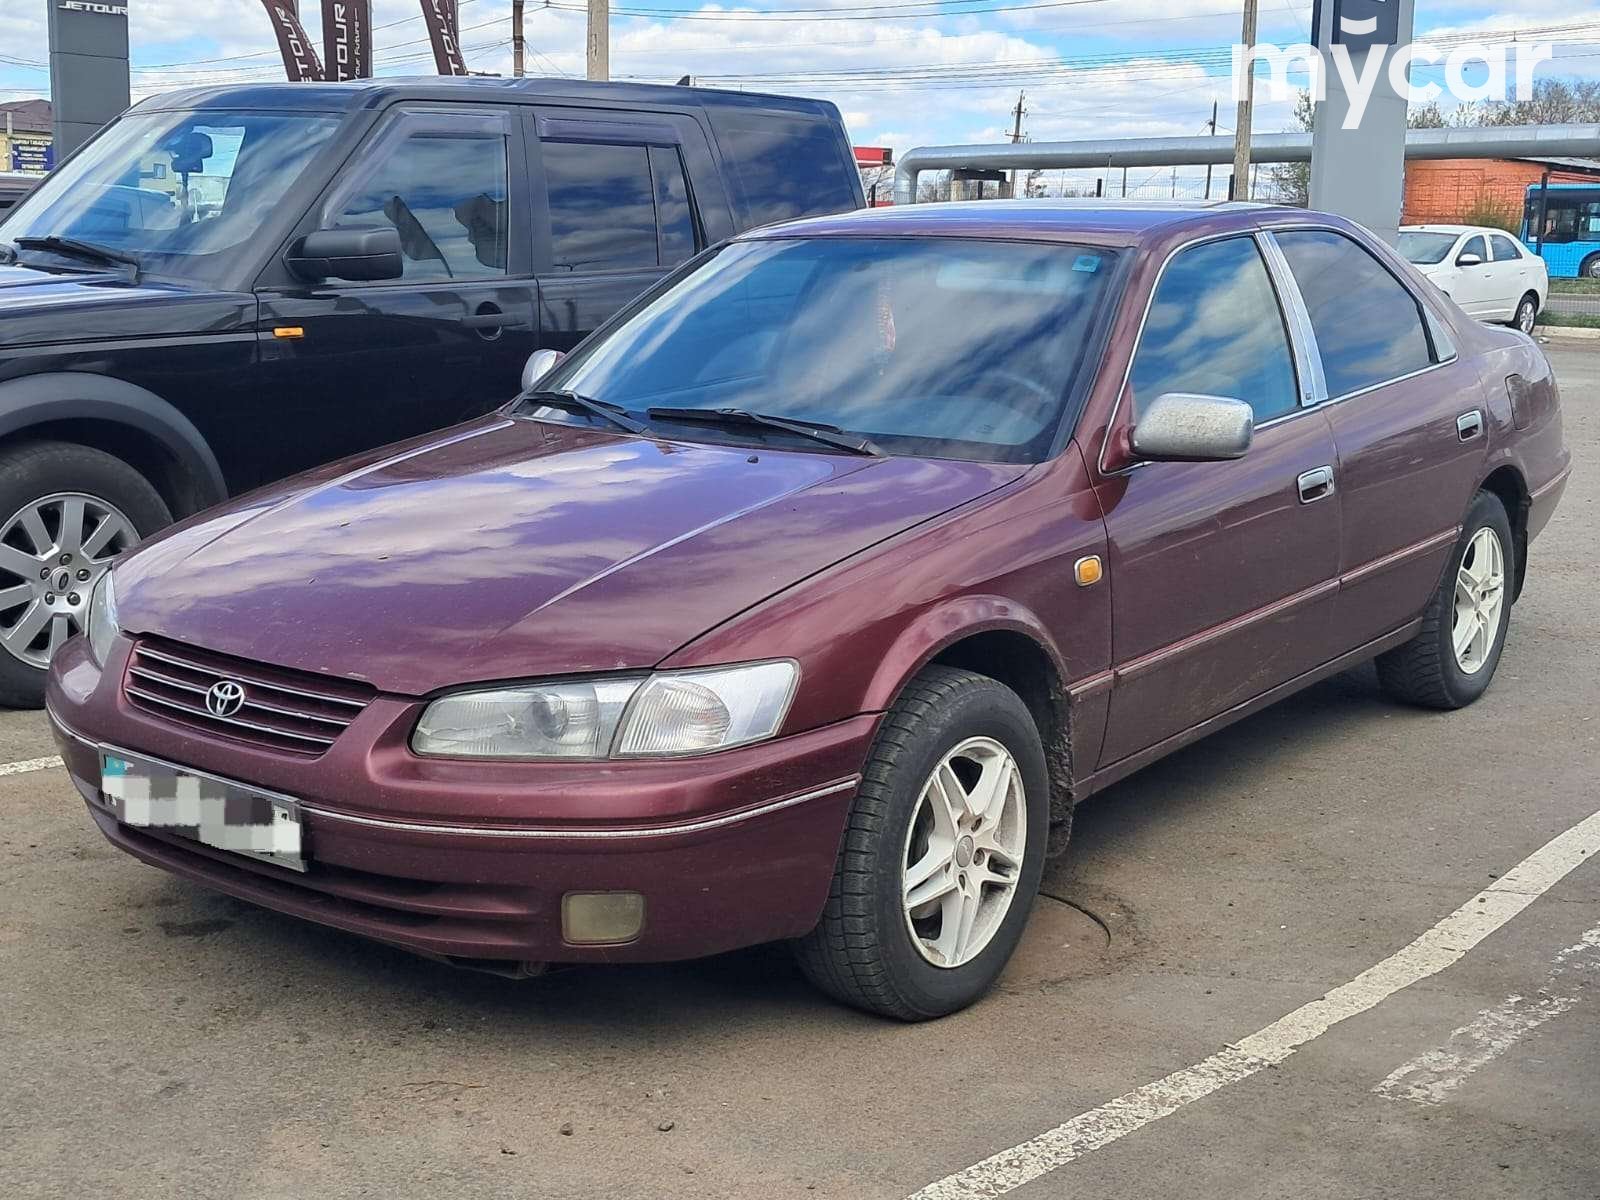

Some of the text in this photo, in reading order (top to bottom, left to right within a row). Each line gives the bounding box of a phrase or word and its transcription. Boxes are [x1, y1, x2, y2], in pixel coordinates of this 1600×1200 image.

[58, 0, 129, 16] JETOUR
[275, 6, 312, 82] TOUR
[334, 3, 348, 82] TOUR
[432, 0, 459, 76] TOUR
